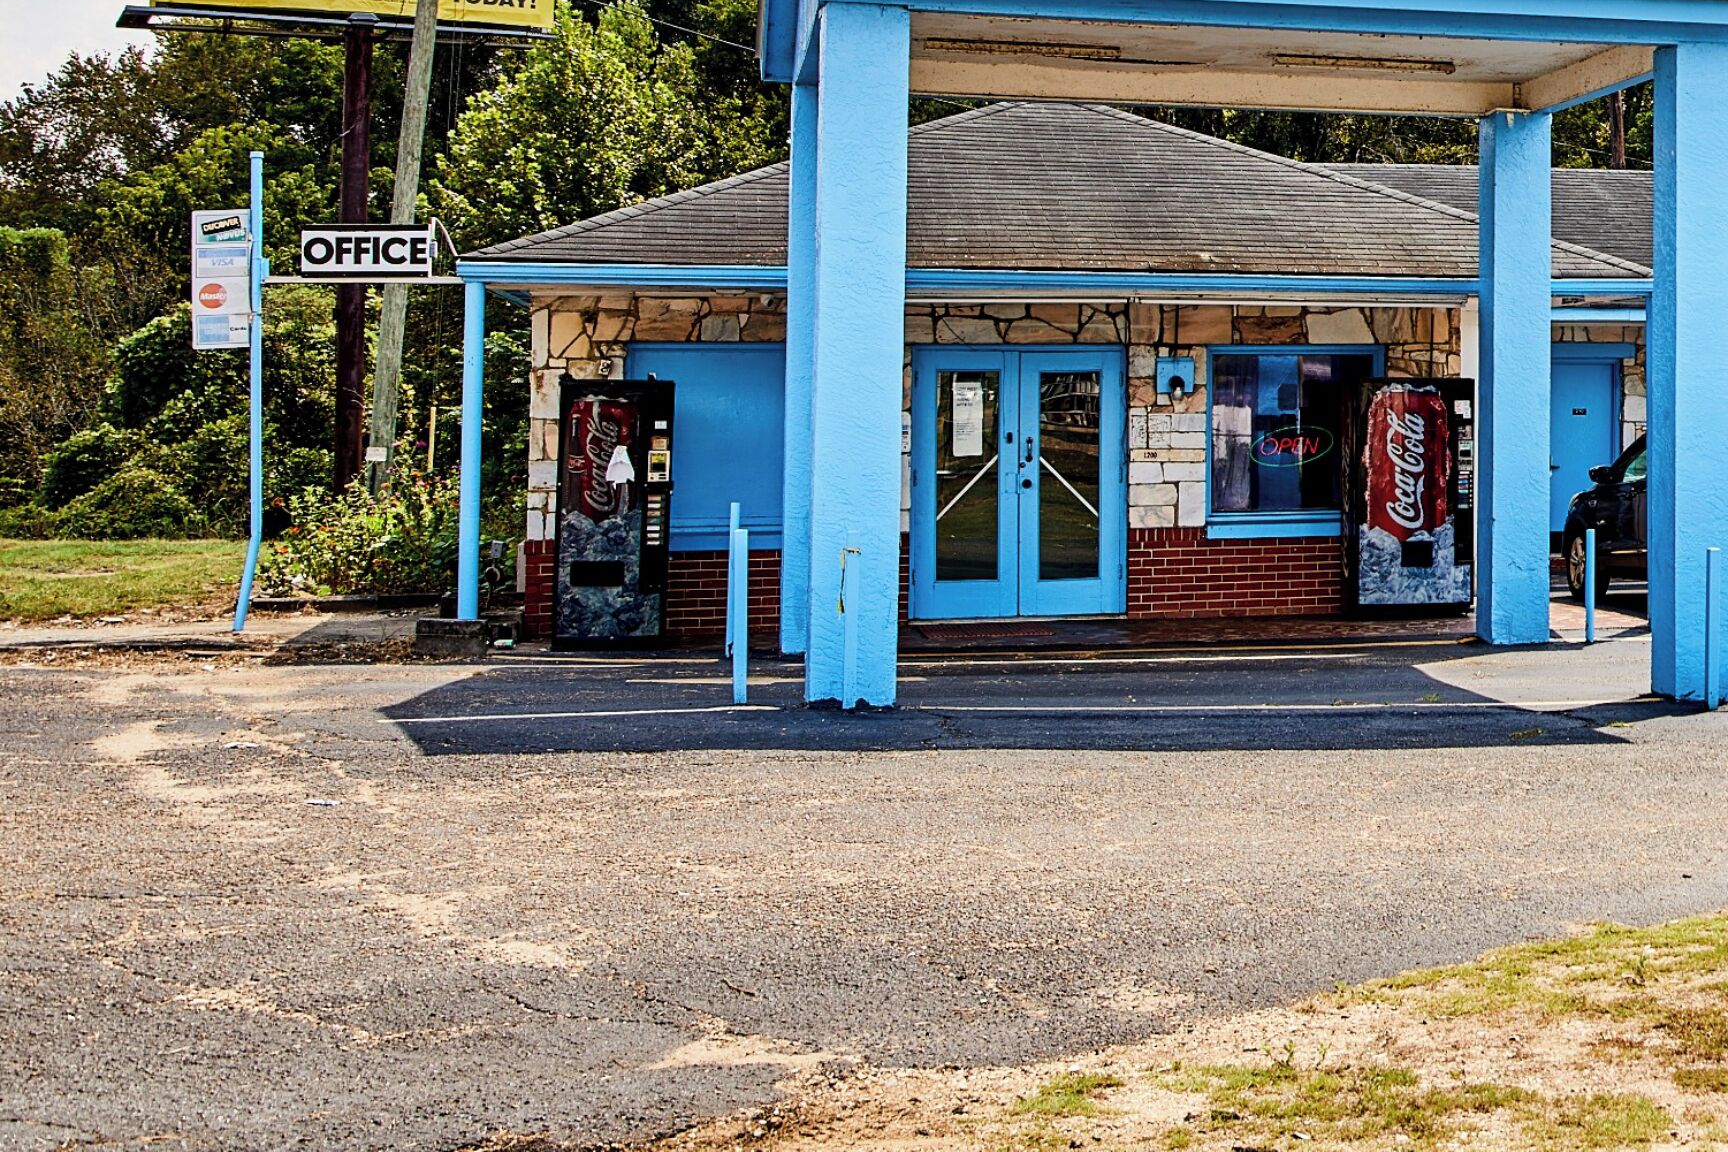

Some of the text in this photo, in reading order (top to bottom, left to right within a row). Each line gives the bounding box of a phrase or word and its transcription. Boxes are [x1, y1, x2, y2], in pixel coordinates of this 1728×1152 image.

[303, 237, 428, 265] OFFICE
[211, 258, 235, 266] VISA
[1260, 436, 1319, 456] OPEN
